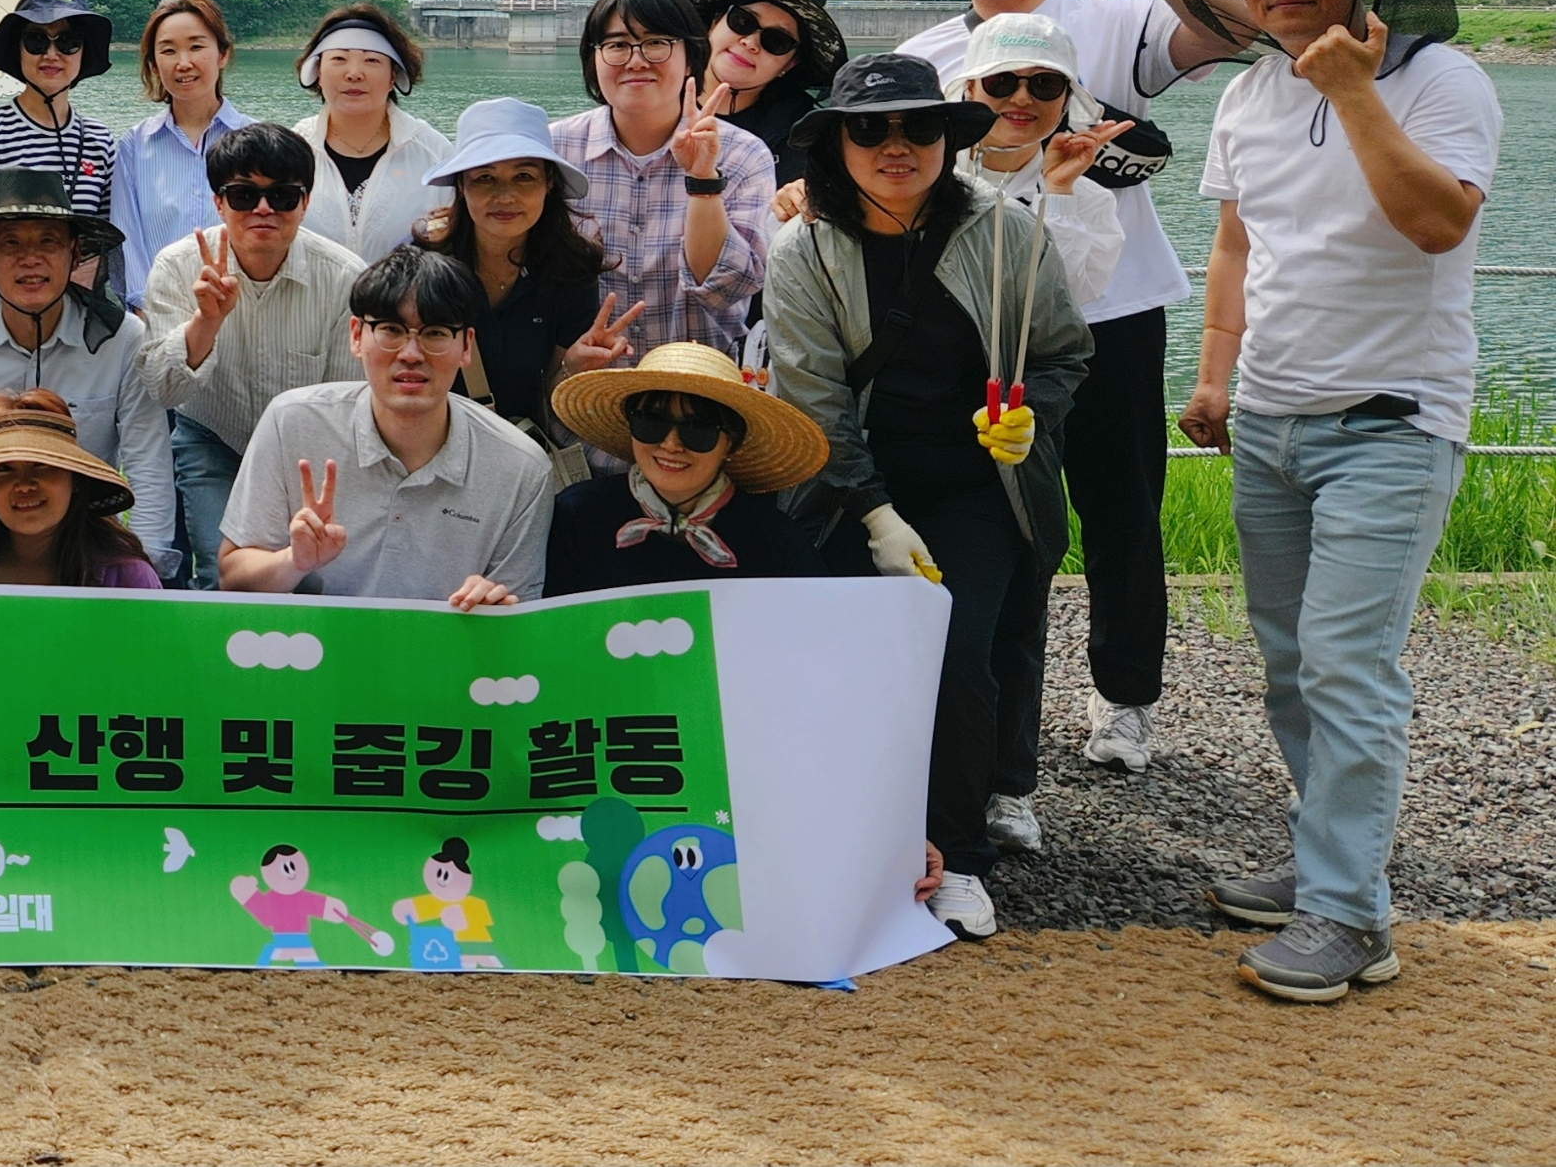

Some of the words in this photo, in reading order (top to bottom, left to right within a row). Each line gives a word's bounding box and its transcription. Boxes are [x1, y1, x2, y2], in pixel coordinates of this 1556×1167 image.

[1094, 144, 1158, 180] idas
[448, 509, 480, 524] Columbia
[26, 713, 185, 793] 산행
[221, 718, 295, 795] 및
[331, 723, 494, 801] 줍깅
[527, 714, 685, 800] 활동
